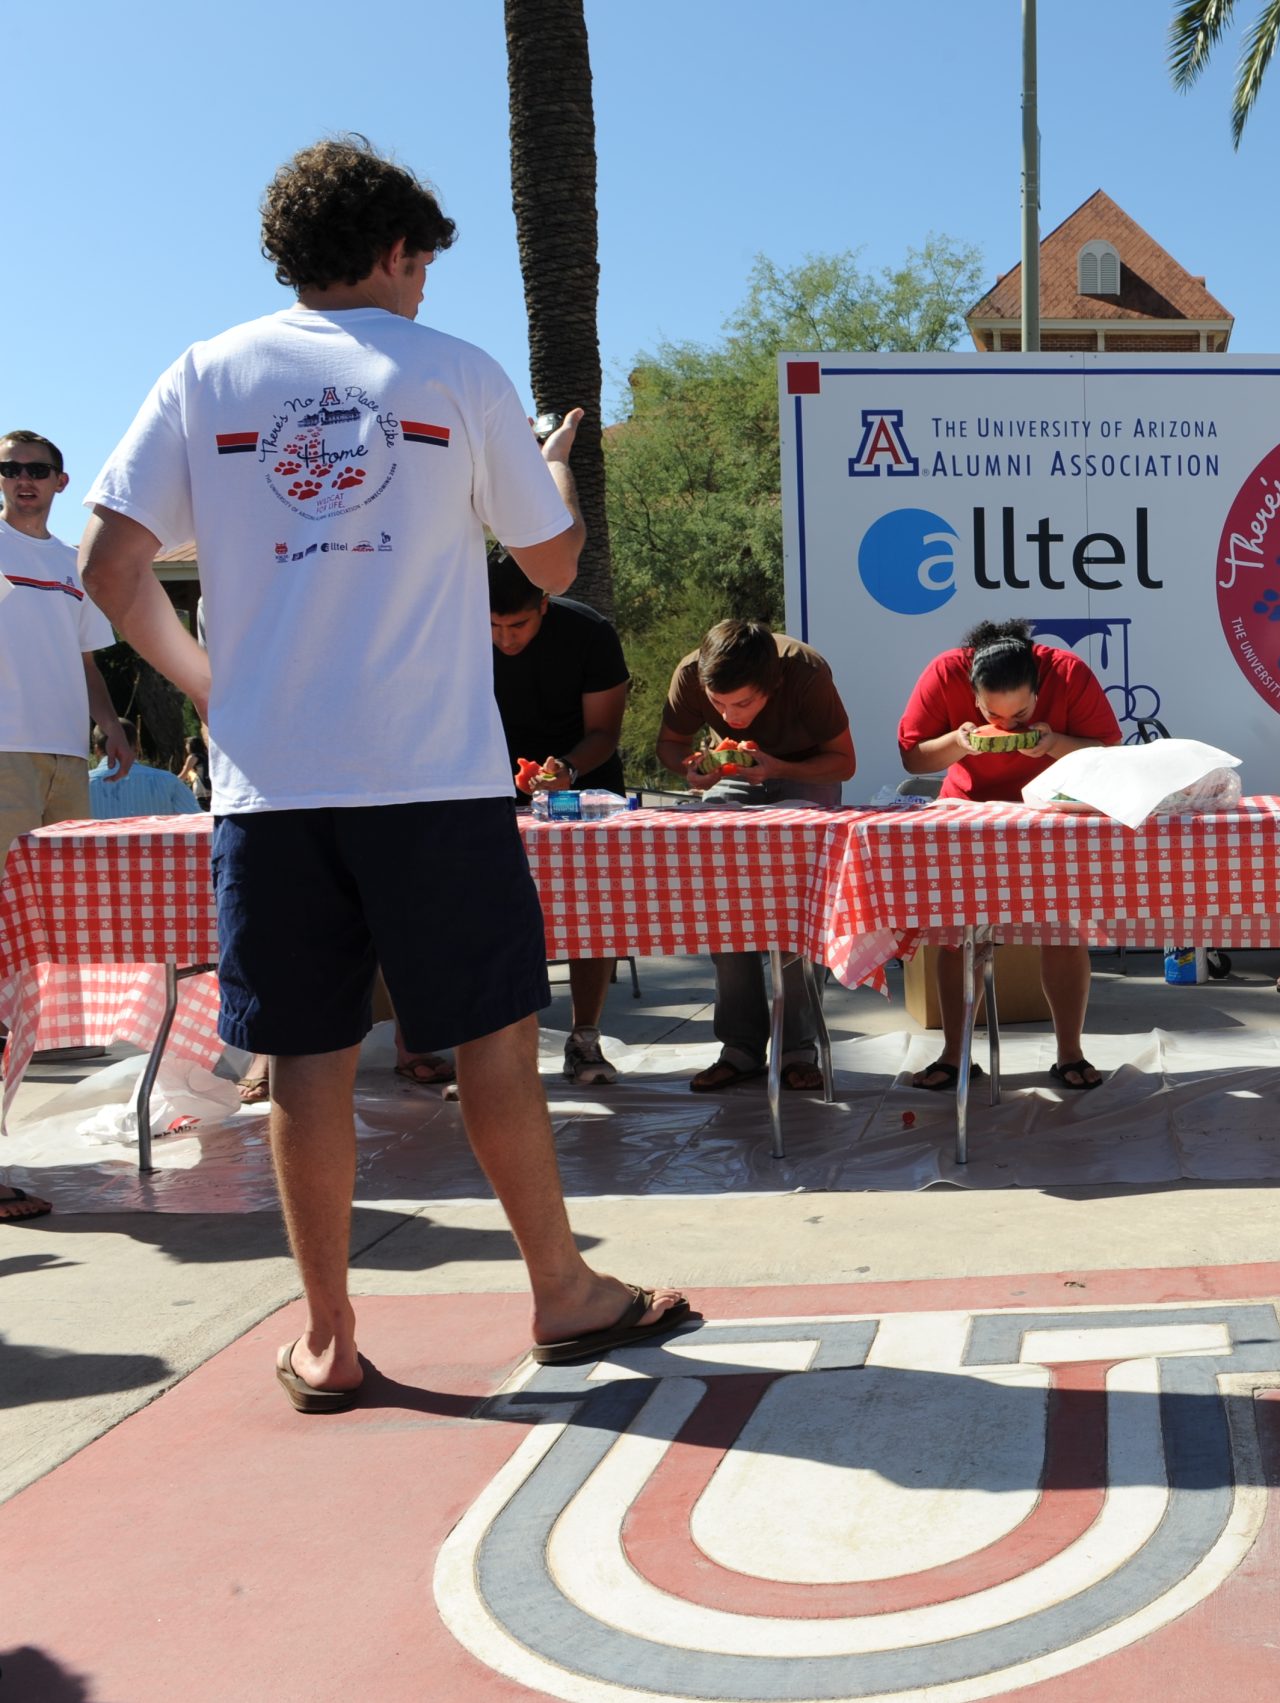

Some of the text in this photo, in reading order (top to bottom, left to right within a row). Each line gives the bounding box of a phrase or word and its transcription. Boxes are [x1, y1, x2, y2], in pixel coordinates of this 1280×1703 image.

[259, 386, 399, 463] There's No A Place Like
[932, 417, 1218, 438] THE UNIVERSITY OF ARIZONA
[297, 439, 368, 469] Home
[848, 409, 919, 477] A
[932, 451, 1220, 477] ALUMNI ASSOCIATION
[917, 507, 1163, 591] alltel
[1231, 616, 1247, 640] THE
